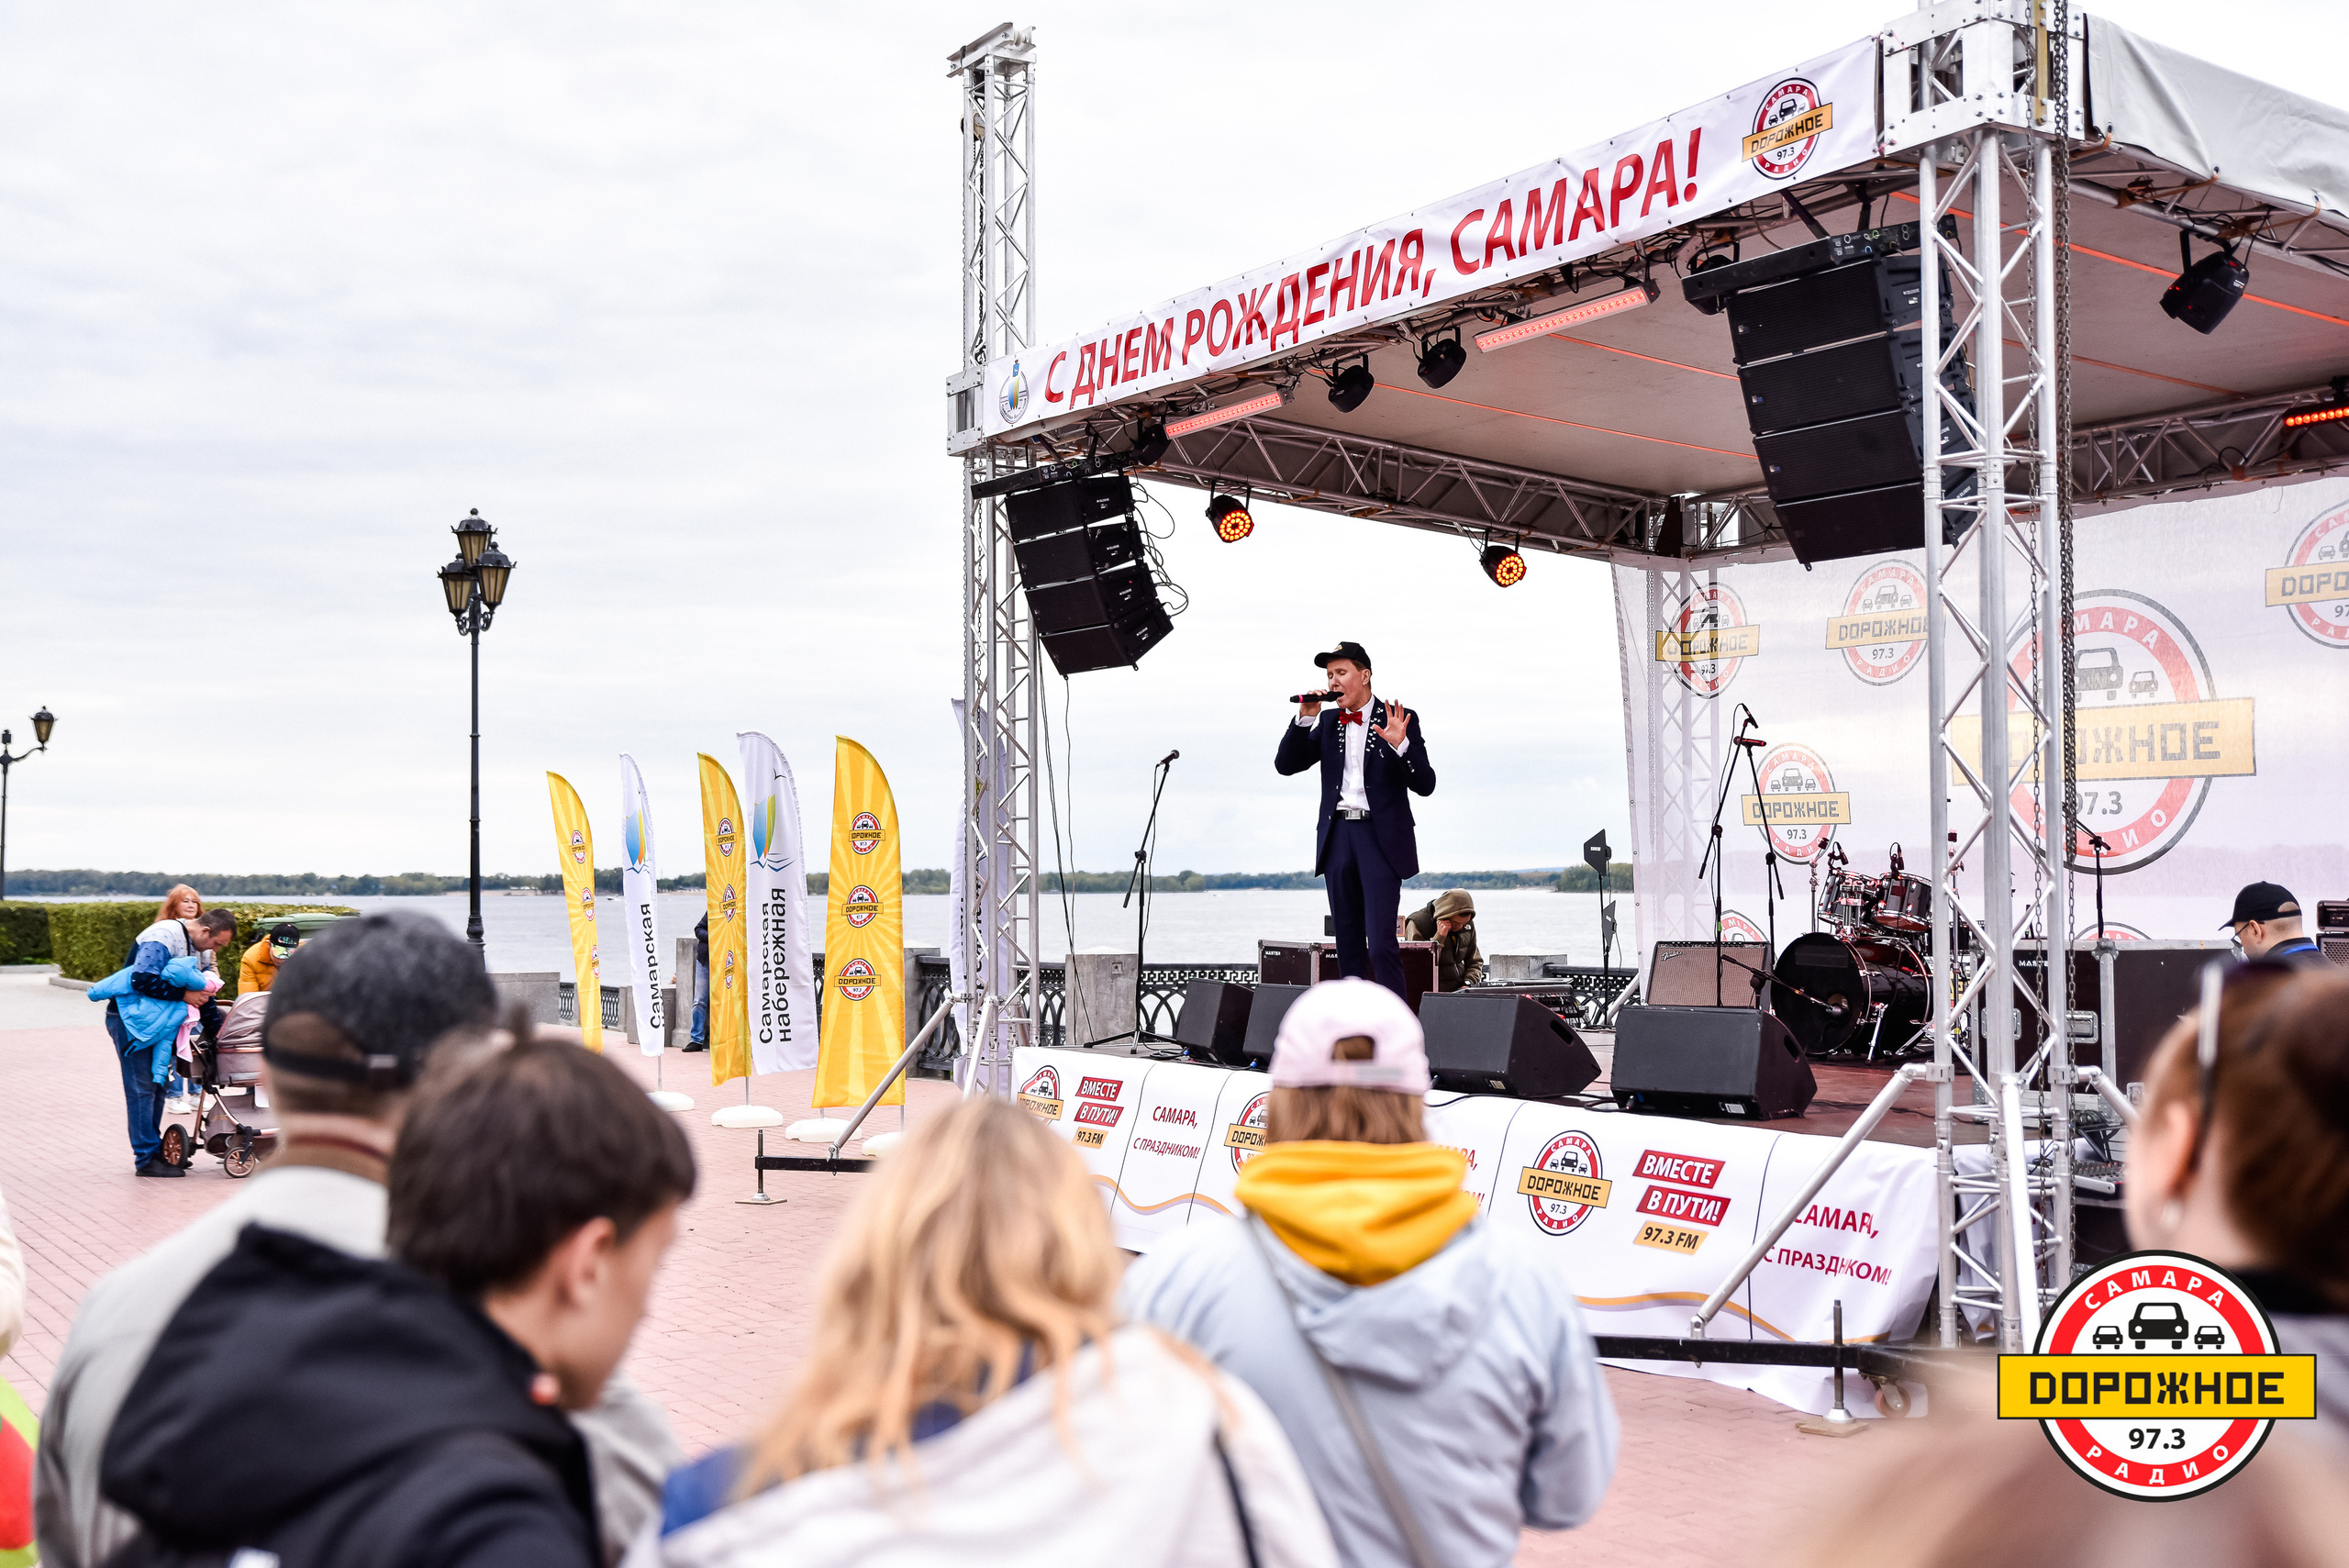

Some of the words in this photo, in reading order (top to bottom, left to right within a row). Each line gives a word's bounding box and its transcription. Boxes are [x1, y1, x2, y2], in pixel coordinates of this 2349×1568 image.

[1765, 86, 1809, 111] САМАРА
[1765, 149, 1808, 172] РАДИО
[1776, 147, 1795, 161] 97.3
[1044, 350, 1067, 404] С
[1070, 317, 1174, 410] ДНЕМ
[1182, 228, 1437, 366] РОЖДЕНИЯ,
[1450, 127, 1702, 275] САМАРА!
[1860, 569, 1916, 592] САМАРА
[1872, 648, 1894, 660] 97.3
[1701, 663, 1716, 675] 97.3
[1856, 654, 1910, 677] РАДИО
[1766, 752, 1815, 773] САМАРА
[1787, 828, 1807, 840] 97.3
[640, 903, 661, 1029] Самарская
[760, 903, 773, 1044] Самарская
[772, 888, 792, 1042] набережная
[1080, 1080, 1119, 1099] ВМЕСТЕ
[1079, 1105, 1089, 1119] В
[1086, 1106, 1119, 1125] ПУТИ!
[1152, 1106, 1198, 1129] САМАРА,
[1076, 1130, 1092, 1143] 97.3
[1091, 1132, 1104, 1145] FM
[1133, 1137, 1141, 1149] С
[1140, 1139, 1201, 1159] ПРАЗДНИКОМ!
[1550, 1137, 1592, 1157] САМАРА
[1642, 1154, 1715, 1184] ВМЕСТЕ
[1550, 1203, 1567, 1215] 97.3
[1646, 1190, 1663, 1210] В
[1661, 1192, 1722, 1222] ПУТИ!
[1537, 1207, 1578, 1229] РАДИО
[1643, 1226, 1675, 1244] 97.3
[1675, 1231, 1699, 1250] FM
